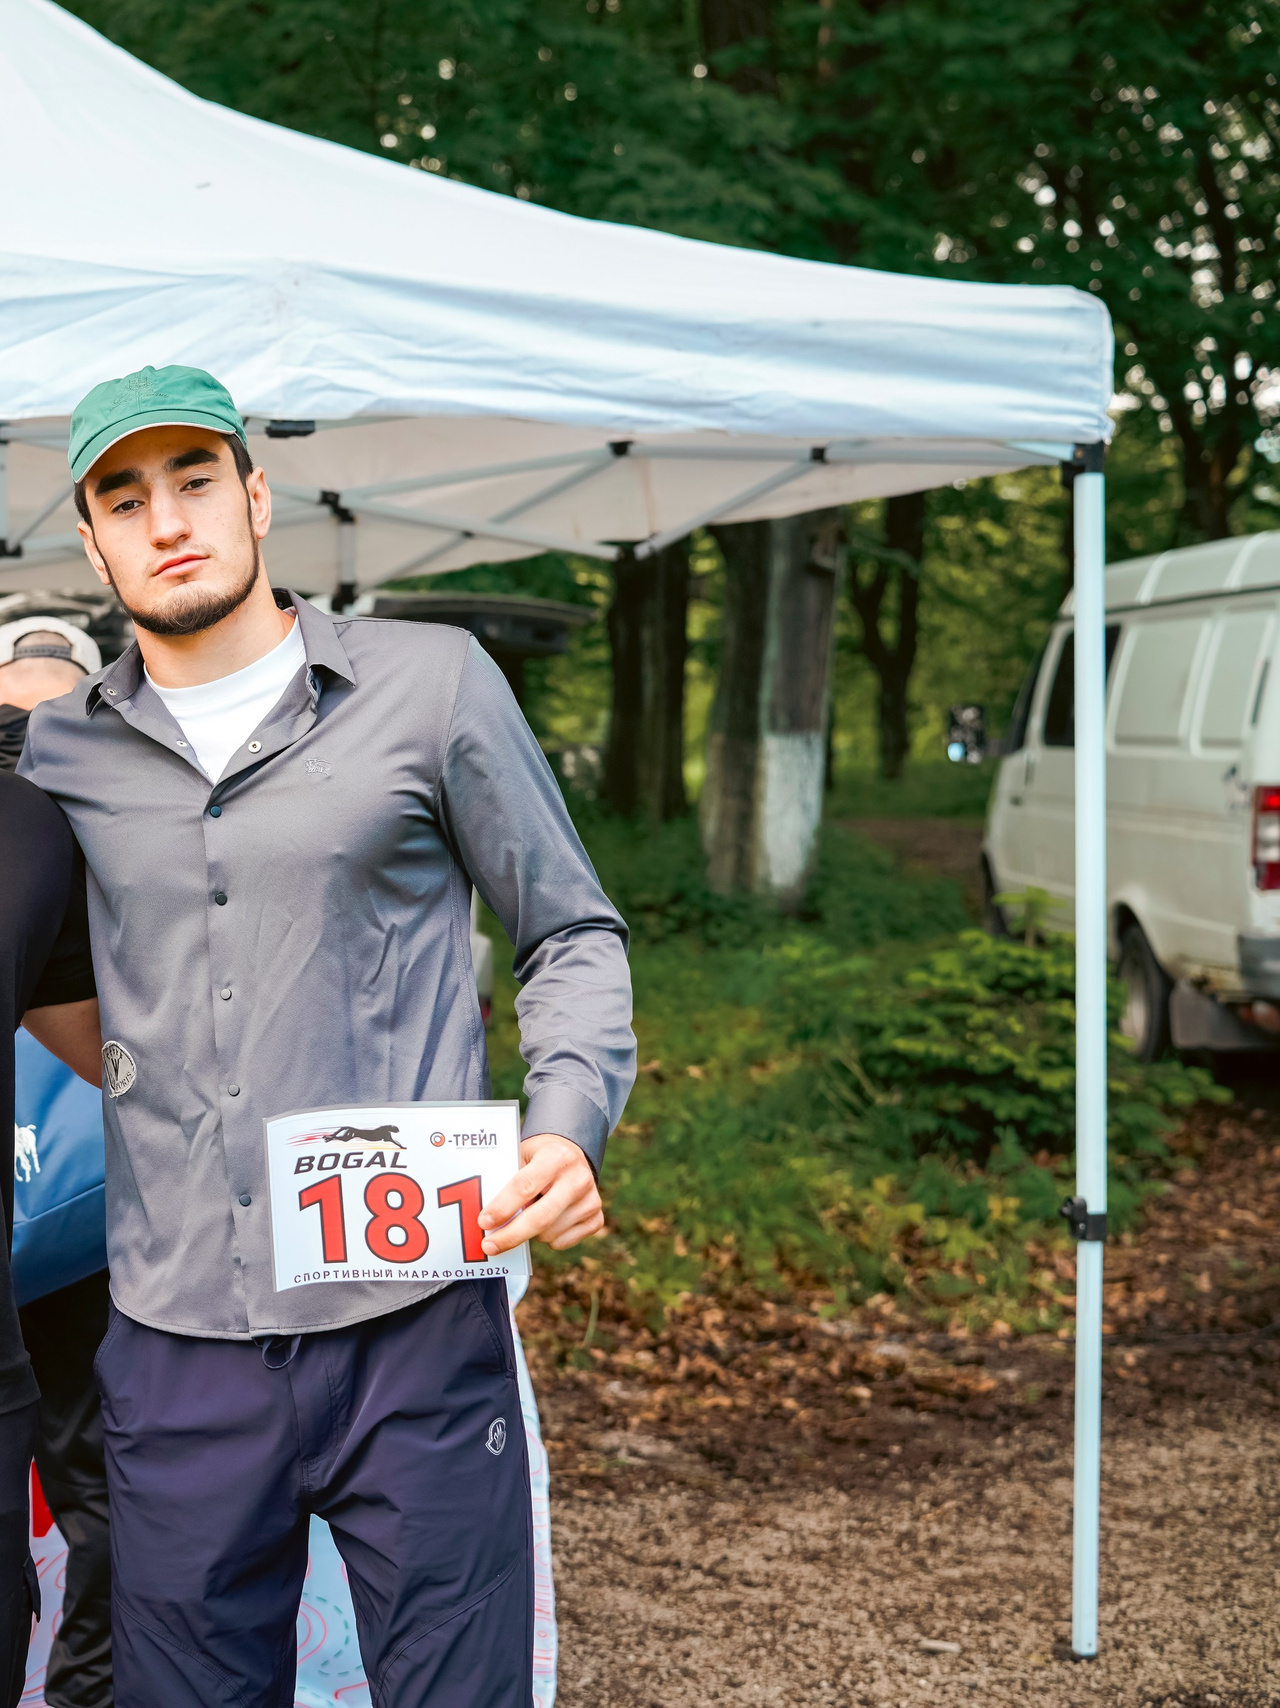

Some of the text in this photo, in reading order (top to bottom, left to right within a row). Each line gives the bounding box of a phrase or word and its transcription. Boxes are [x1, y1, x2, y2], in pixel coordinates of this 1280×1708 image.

[293, 1151, 408, 1175] BOGAL
[298, 1171, 489, 1264] 181
[294, 1266, 509, 1284] СПОРТИВНЫЙ МАРАФОН 2026
